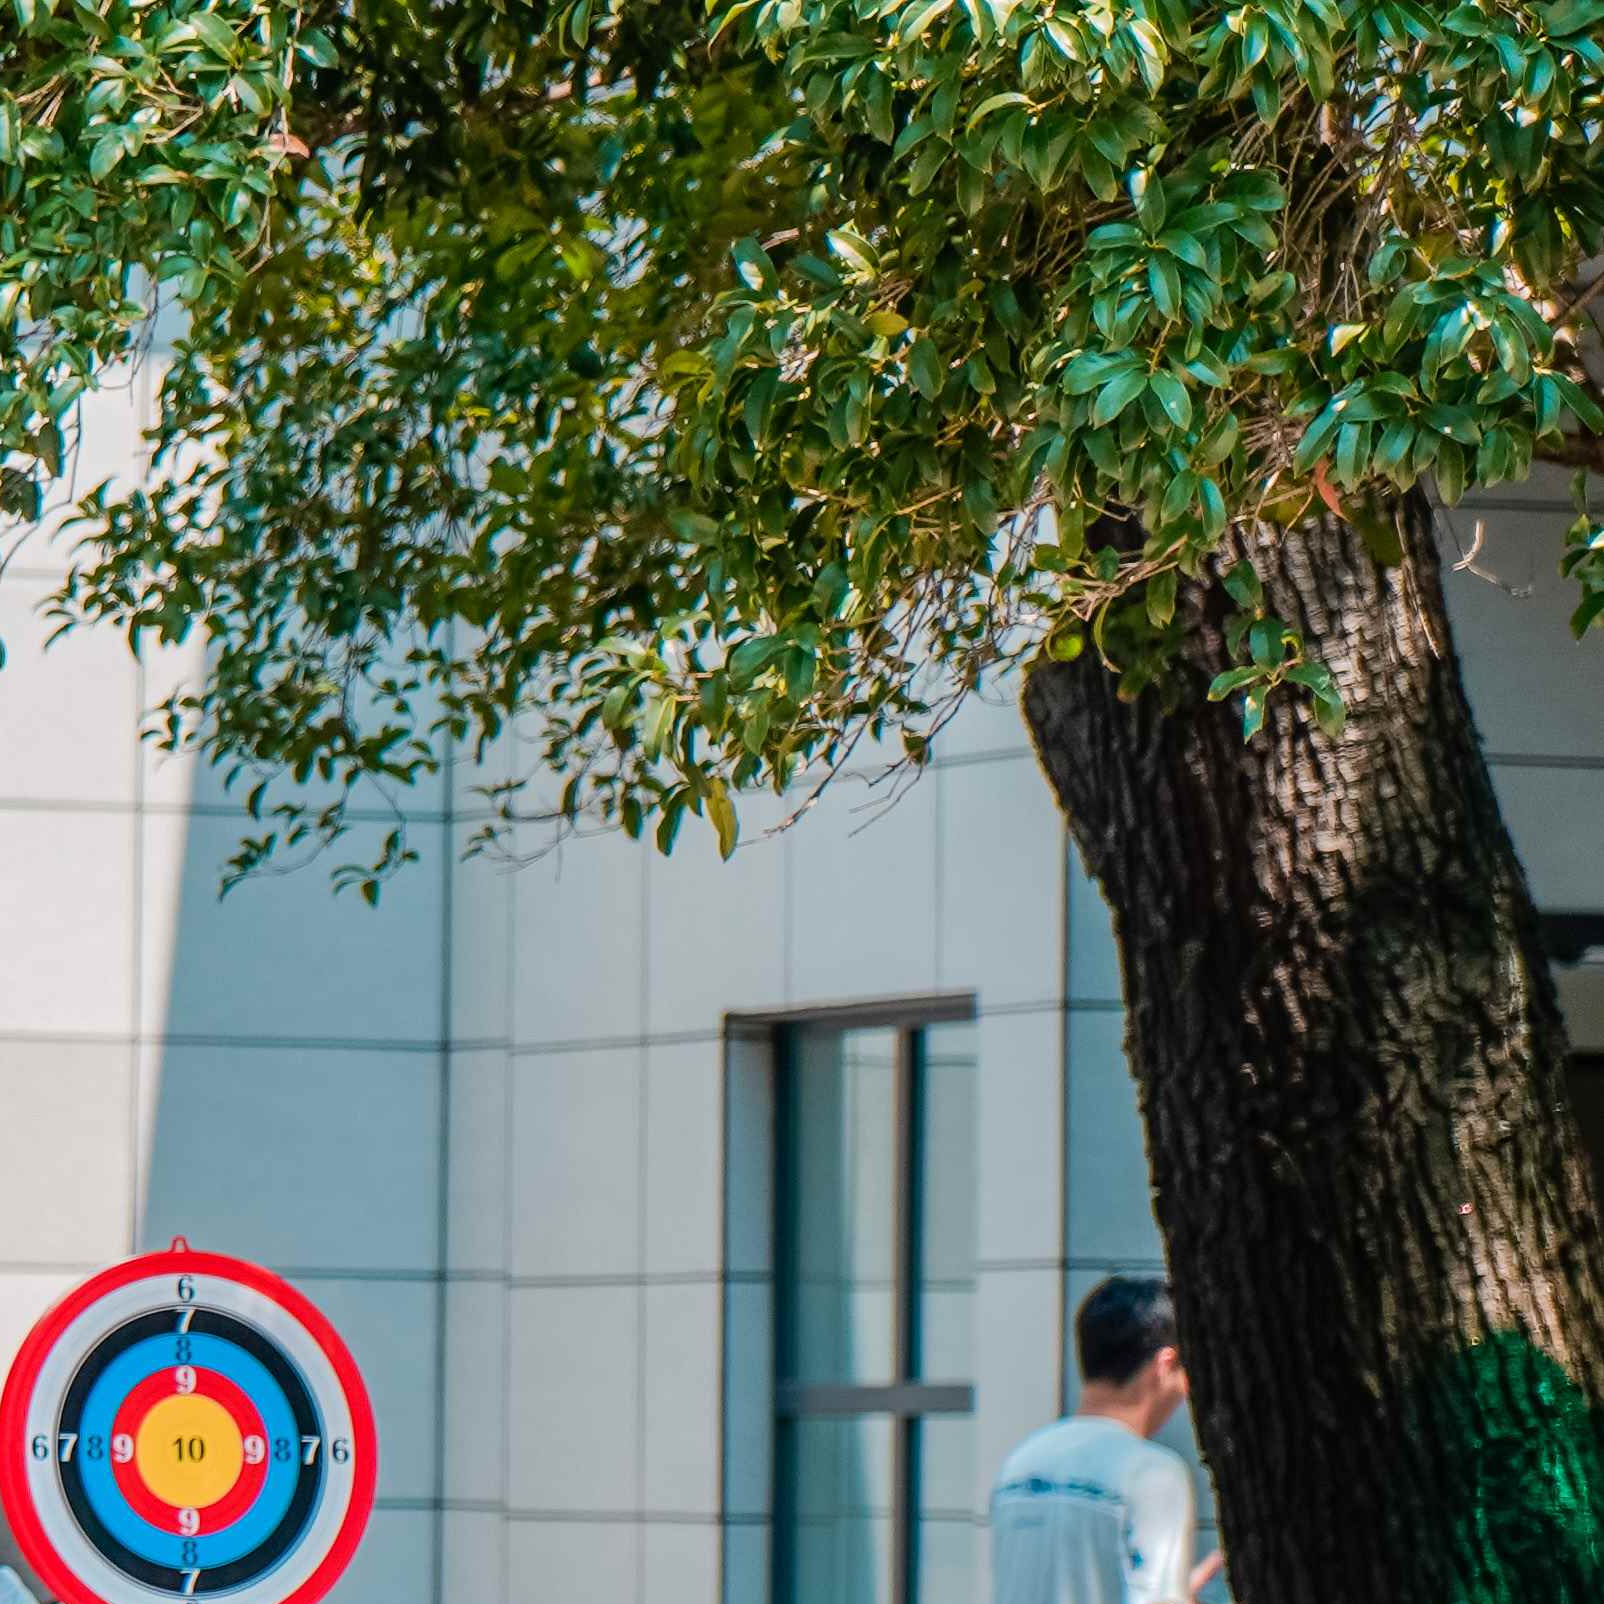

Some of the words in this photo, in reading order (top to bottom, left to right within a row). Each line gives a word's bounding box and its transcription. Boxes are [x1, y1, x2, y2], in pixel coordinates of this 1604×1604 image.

[177, 1275, 195, 1303] 6
[175, 1305, 196, 1334] 7
[175, 1336, 192, 1365] 8
[175, 1365, 197, 1394] 9
[31, 1435, 49, 1461] 6
[58, 1433, 78, 1462] 7
[87, 1435, 104, 1462] 8
[112, 1434, 135, 1463] 9
[172, 1437, 205, 1464] 10
[242, 1435, 265, 1464] 9
[274, 1436, 291, 1463] 8
[301, 1435, 321, 1465] 7
[332, 1438, 349, 1464] 6
[178, 1507, 201, 1537] 9
[181, 1538, 198, 1567] 8
[179, 1567, 201, 1597] 7
